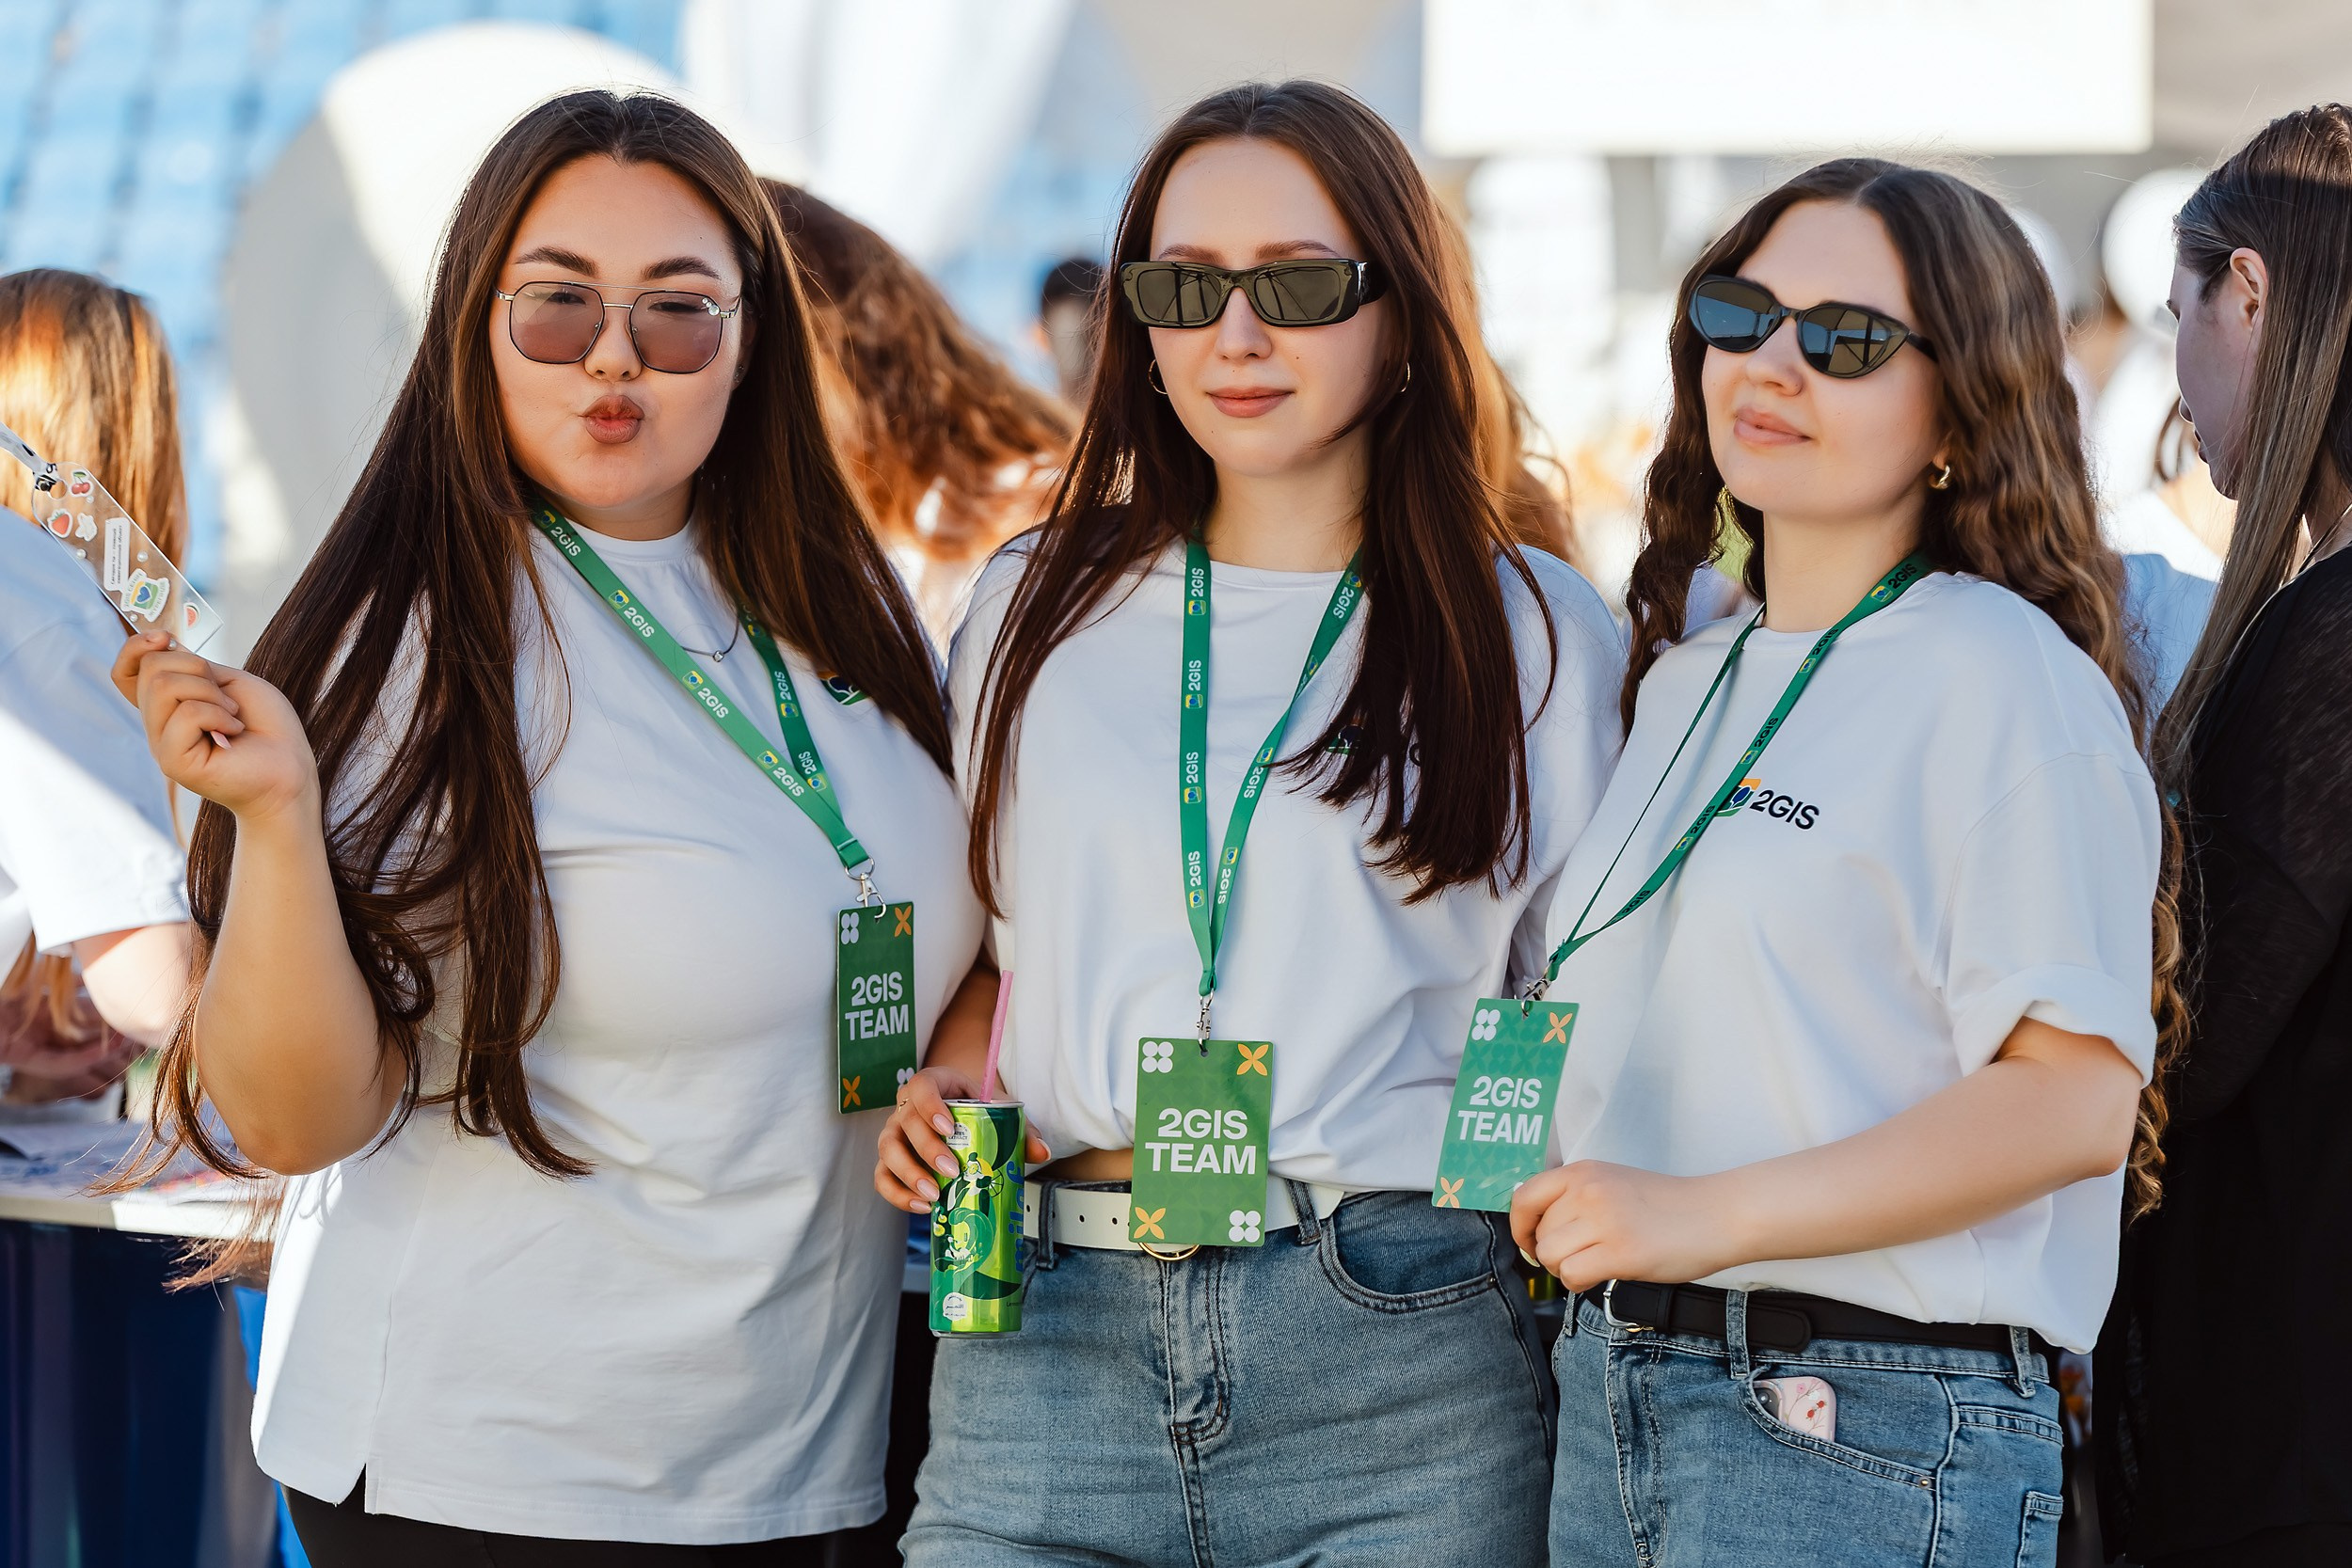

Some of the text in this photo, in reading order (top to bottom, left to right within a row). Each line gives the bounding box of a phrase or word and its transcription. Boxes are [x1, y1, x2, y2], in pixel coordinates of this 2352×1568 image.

[550, 526, 580, 557] 2GIS
[1191, 567, 1204, 597] 2GIS
[1887, 563, 1917, 589] 2GIS
[1332, 586, 1355, 620] 2GIS
[624, 608, 655, 638] 2GIS
[1812, 628, 1838, 656] 2GIS
[774, 671, 790, 701] 2GIS
[1188, 659, 1202, 691] 2GIS
[697, 688, 728, 719] 2GIS
[1755, 717, 1778, 747] 2GIS
[799, 751, 817, 774] 2GIS
[1186, 752, 1200, 784] 2GIS
[773, 767, 804, 798] 2GIS
[1244, 766, 1263, 800] 2GIS
[1690, 803, 1716, 834] 2GIS
[1750, 790, 1820, 830] 2GIS
[1188, 850, 1202, 887] 2GIS
[1217, 867, 1231, 904] 2GIS
[1622, 890, 1650, 915] 2GIS
[851, 972, 903, 1006] 2GIS
[845, 1005, 909, 1041] TEAM
[1470, 1076, 1542, 1109] 2GIS
[1158, 1108, 1248, 1139] 2GIS
[1457, 1110, 1543, 1145] TEAM
[1145, 1142, 1256, 1175] TEAM
